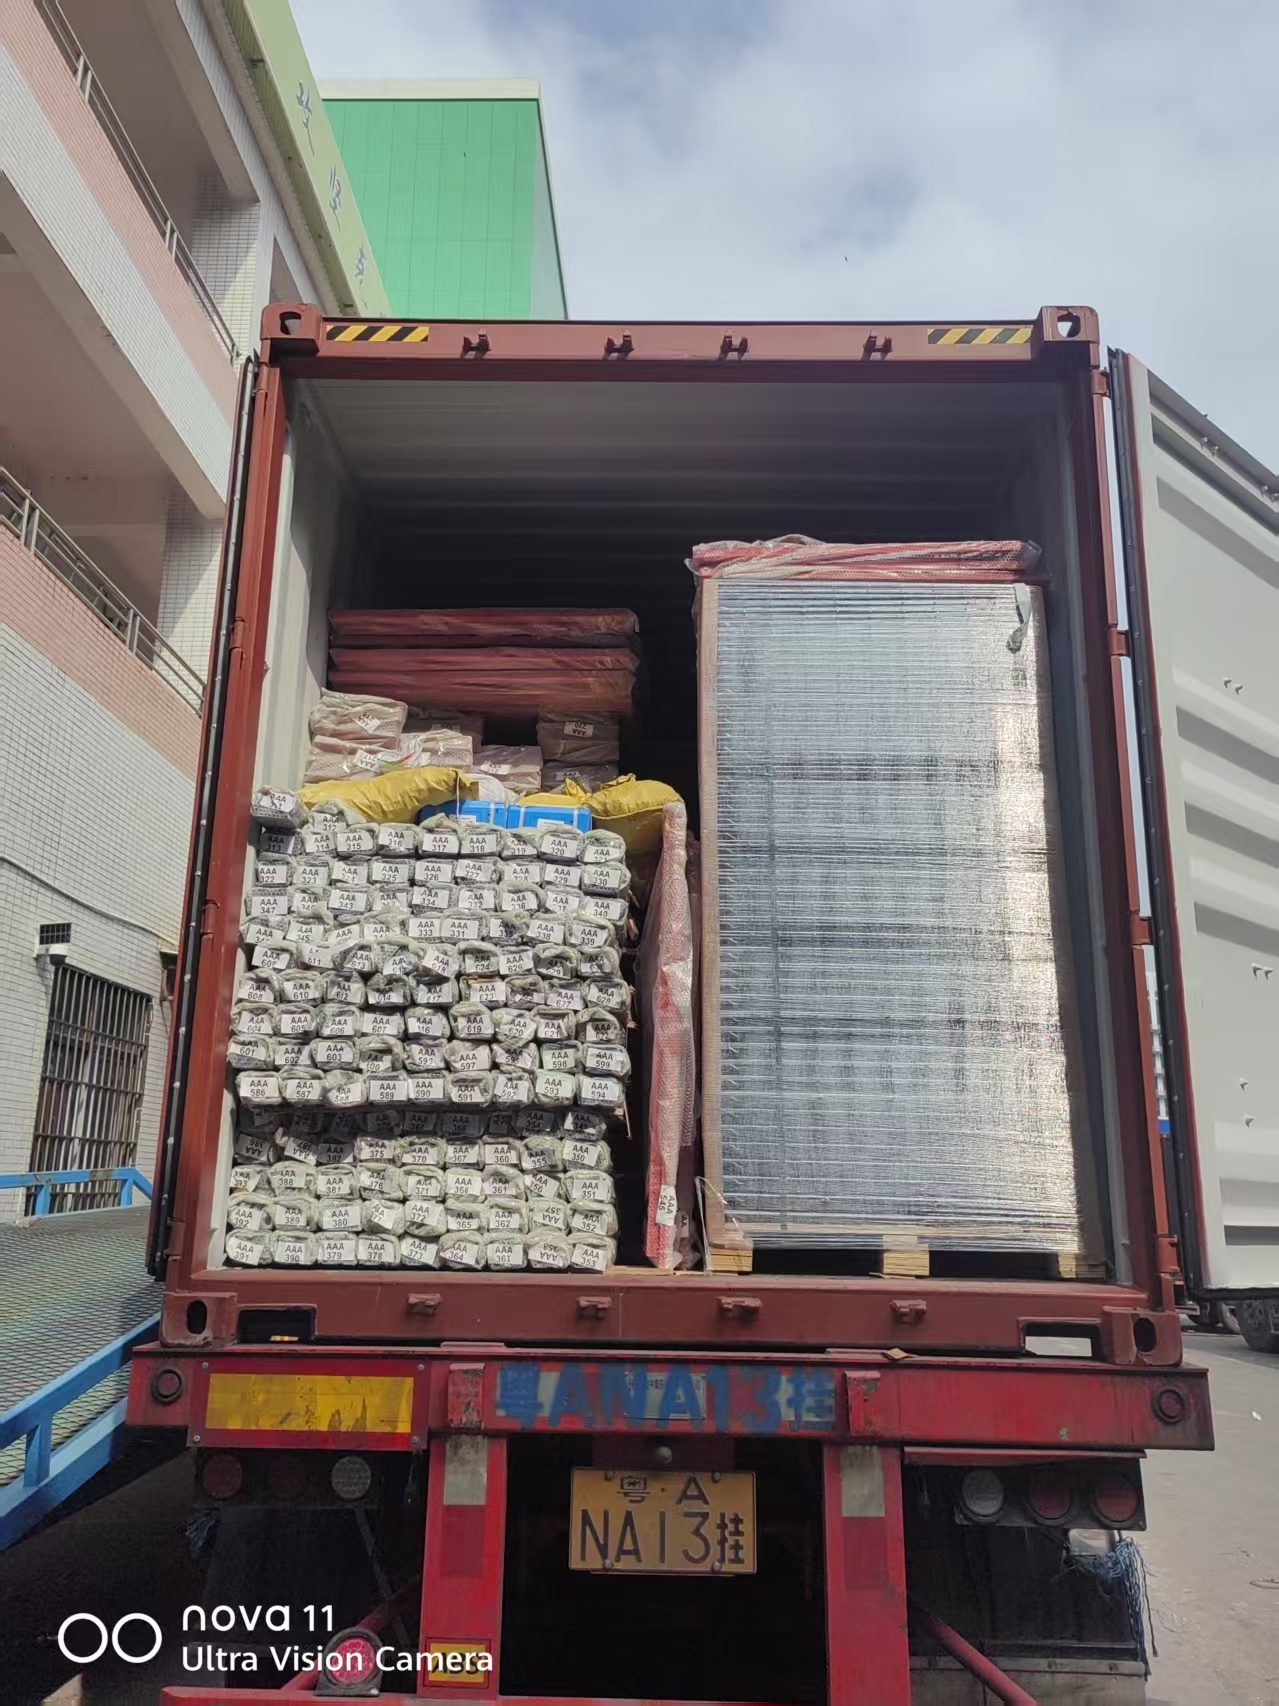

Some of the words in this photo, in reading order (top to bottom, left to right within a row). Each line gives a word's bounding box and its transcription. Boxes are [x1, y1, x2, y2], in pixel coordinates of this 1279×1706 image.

[388, 831, 405, 839] AAA
[314, 835, 330, 844] AAA
[550, 839, 568, 848] AAA
[315, 842, 329, 850] 314
[431, 844, 446, 852] 317
[550, 847, 565, 855] 320
[465, 862, 482, 872] AAA
[301, 868, 319, 876] AAA
[553, 868, 571, 876] AAA
[592, 869, 610, 878] AAA
[592, 877, 607, 885] 330
[421, 890, 439, 899] AAA
[510, 894, 527, 902] AAA
[339, 901, 354, 909] 343
[421, 897, 436, 906] 334
[594, 901, 610, 909] AAA
[592, 908, 608, 917] 340
[450, 921, 468, 929] AAA
[537, 923, 555, 932] AAA
[535, 931, 551, 940] 338
[580, 928, 598, 937] AAA
[580, 937, 595, 946] 339
[506, 955, 524, 964] AAA
[507, 963, 523, 973] 626
[248, 984, 266, 992] AAA
[292, 982, 310, 990] AAA
[247, 992, 263, 1000] 608
[293, 991, 309, 999] 610
[557, 991, 574, 1001] AAA
[290, 1016, 308, 1024] AAA
[466, 1016, 484, 1024] AAA
[510, 1019, 527, 1028] AAA
[467, 1025, 482, 1033] 619
[508, 1028, 523, 1036] 620
[284, 1047, 302, 1055] AAA
[326, 1044, 344, 1052] AAA
[284, 1056, 299, 1064] 602
[459, 1053, 477, 1062] AAA
[595, 1052, 613, 1060] AAA
[460, 1061, 475, 1070] 597
[552, 1060, 567, 1068] 598
[595, 1060, 610, 1068] 599
[295, 1081, 314, 1089] AAA
[415, 1081, 433, 1089] AAA
[544, 1078, 562, 1087] AAA
[591, 1082, 609, 1090] AAA
[379, 1083, 397, 1091] AAA
[543, 1087, 559, 1095] 593
[250, 1088, 266, 1096] 586
[296, 1090, 311, 1098] 587
[368, 1140, 386, 1149] AAA
[412, 1146, 429, 1154] AAA
[452, 1146, 469, 1154] AAA
[571, 1144, 589, 1154] AAA
[411, 1155, 427, 1163] 370
[494, 1155, 509, 1163] 360
[279, 1178, 294, 1186] 388
[326, 1177, 343, 1185] AAA
[581, 1182, 599, 1190] AAA
[581, 1190, 596, 1198] 351
[666, 1195, 675, 1213] AAA
[235, 1210, 253, 1218] AAA
[331, 1210, 349, 1218] AAA
[495, 1211, 512, 1219] AAA
[582, 1213, 600, 1223] AAA
[284, 1216, 300, 1224] 389
[542, 1213, 559, 1224] AAA
[332, 1219, 348, 1227] 380
[495, 1220, 511, 1228] 362
[580, 1222, 596, 1231] 352
[236, 1242, 254, 1252] AAA
[284, 1245, 303, 1253] AAA
[409, 1240, 428, 1251] AAA
[407, 1249, 423, 1259] 373
[495, 1246, 513, 1254] AAA
[582, 1249, 599, 1259] AAA
[233, 1251, 249, 1261] 391
[285, 1254, 300, 1262] 390
[580, 1257, 596, 1268] 353
[580, 1508, 745, 1565] NA13挂
